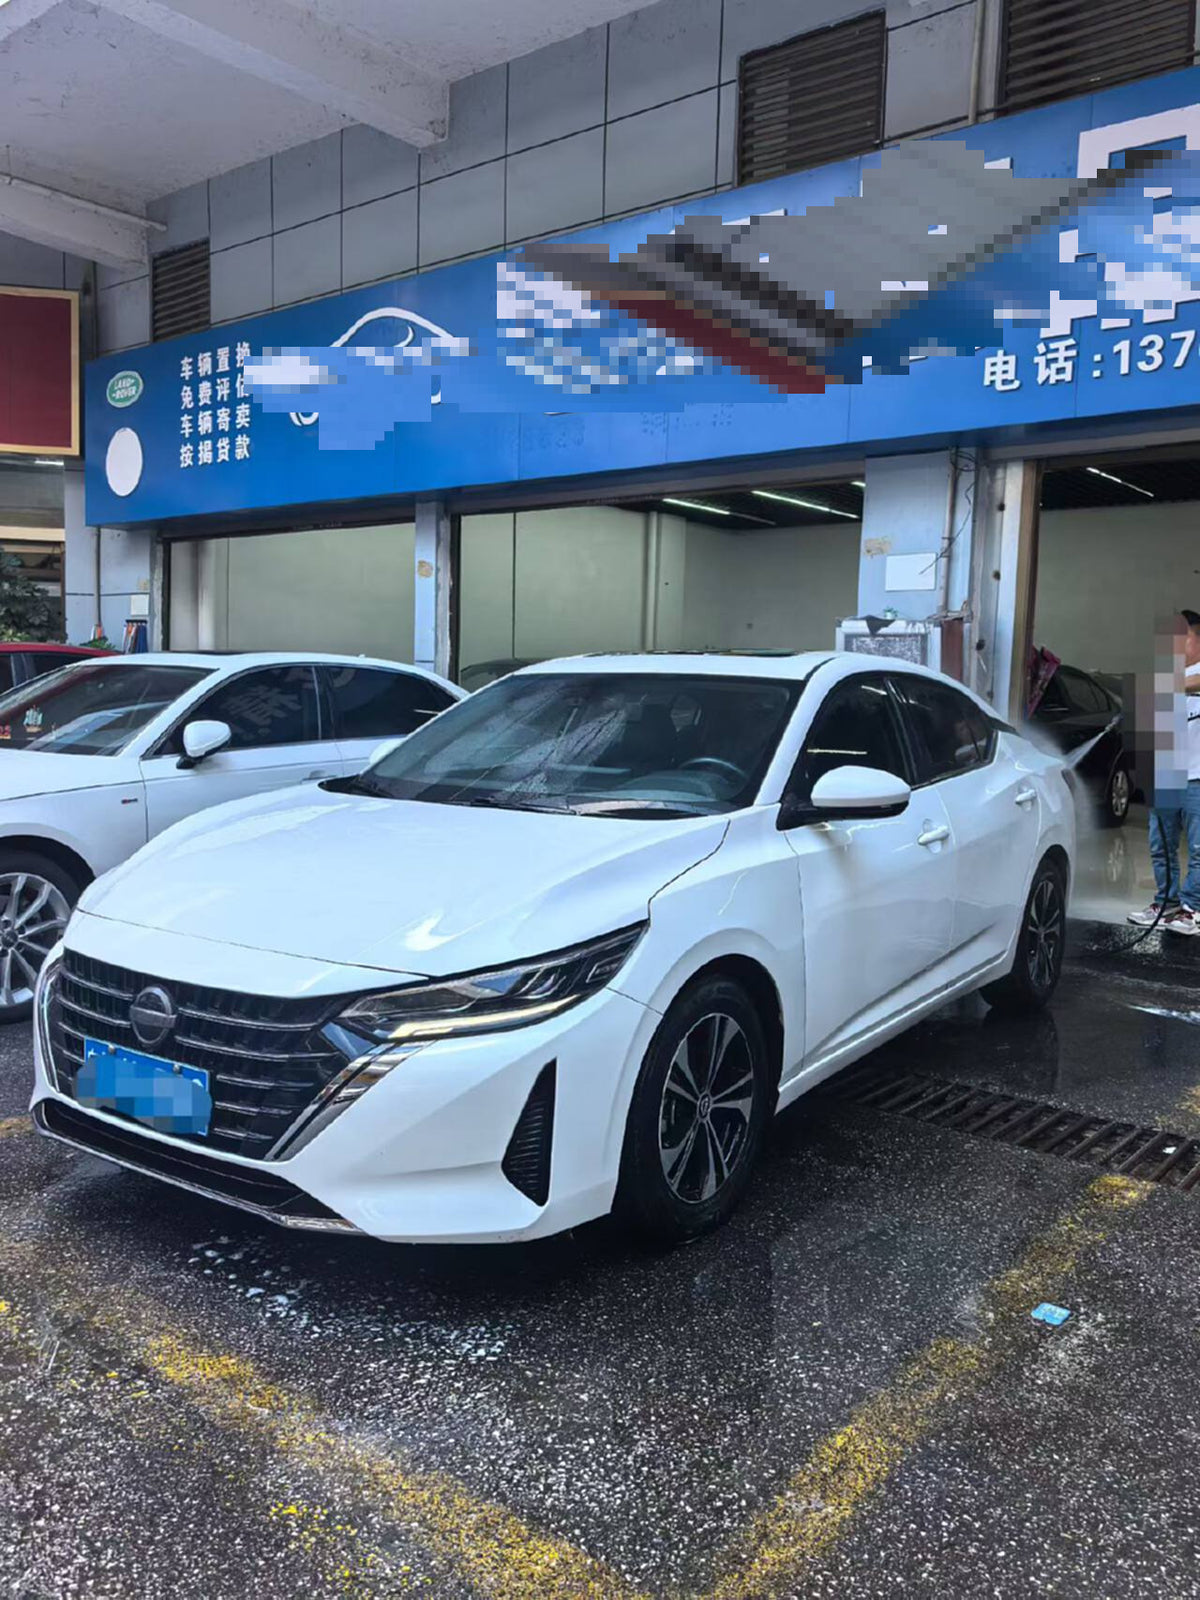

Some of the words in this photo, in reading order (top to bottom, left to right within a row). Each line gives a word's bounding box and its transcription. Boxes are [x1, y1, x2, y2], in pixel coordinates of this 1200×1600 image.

[180, 341, 251, 380] 车辆置换
[983, 328, 1200, 391] 电话:137
[180, 402, 251, 438] 车辆寄卖
[180, 433, 251, 468] 按揭贷款
